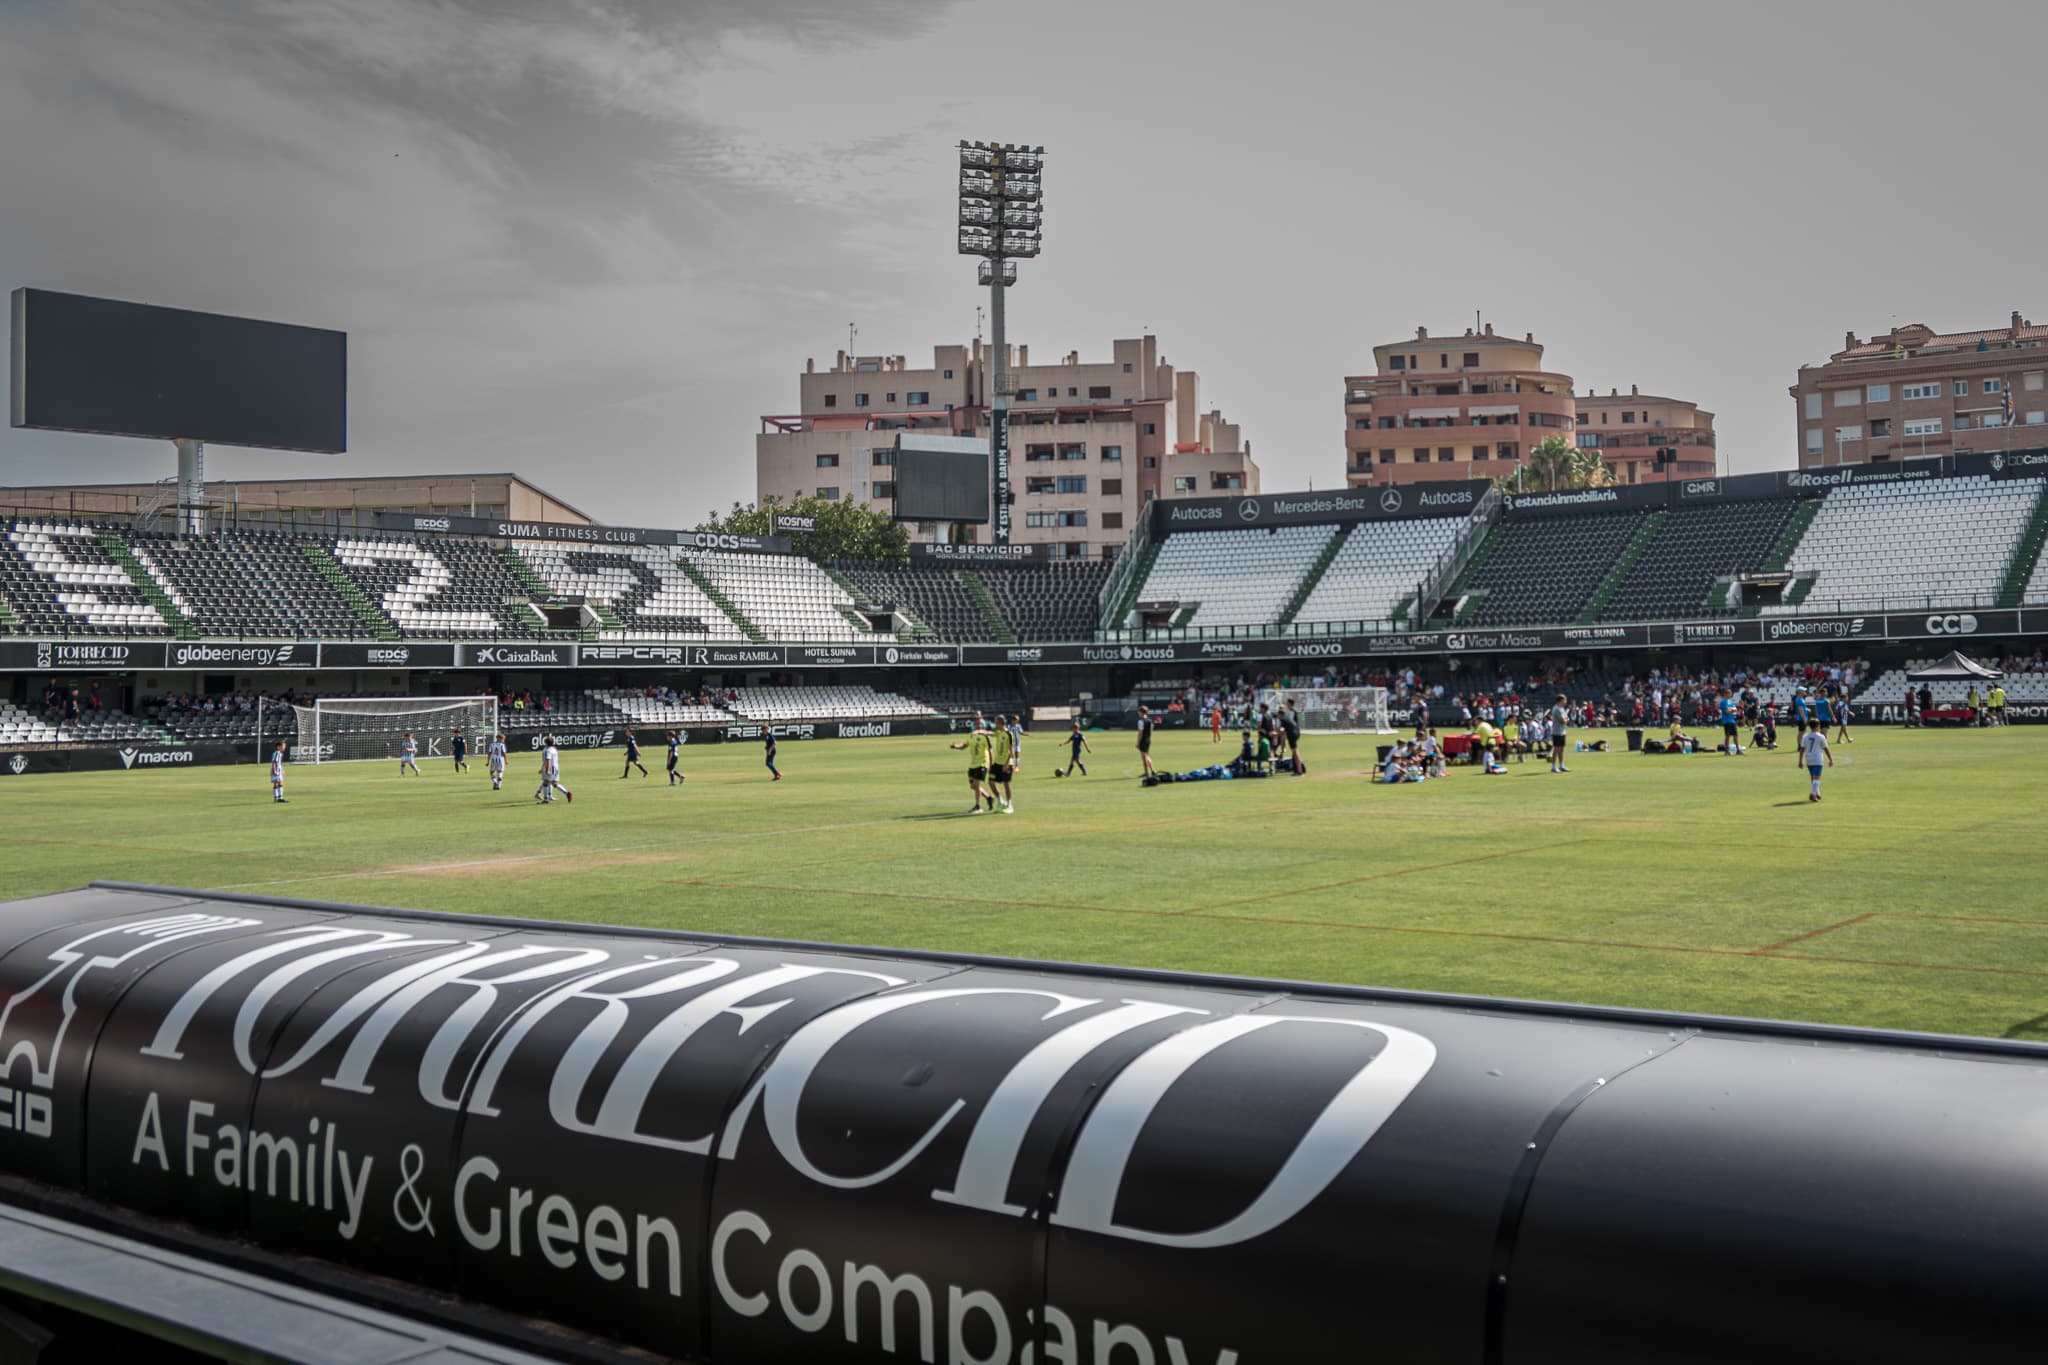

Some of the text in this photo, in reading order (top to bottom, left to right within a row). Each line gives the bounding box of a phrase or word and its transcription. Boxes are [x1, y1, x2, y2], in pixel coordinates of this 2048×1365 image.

[999, 449, 1008, 478] DAMM
[1802, 469, 1931, 487] Rosell DISTRIBUCONES
[1687, 481, 1716, 493] GMR
[1171, 490, 1473, 520] Autocas Mercedes-Benz Autocas
[499, 523, 636, 543] SUMA FITNESS CLUB
[695, 533, 740, 549] CDCS
[925, 544, 1033, 554] SAC SERVICIOS
[1771, 621, 1850, 638] globeenergy
[1926, 614, 1978, 635] CCD
[1564, 628, 1626, 639] HOTEL SUNNA
[55, 646, 129, 659] TORRECID
[177, 645, 276, 665] globeenergy
[582, 647, 682, 659] REPCAR
[805, 648, 856, 657] HOTEL SUNNA
[1083, 645, 1174, 660] frutas bausá
[1202, 643, 1242, 653] Arnau
[1297, 643, 1342, 655] NOVO
[377, 651, 408, 660] CDCS
[496, 649, 558, 663] CaixaBank
[713, 651, 738, 661] fincas
[739, 651, 778, 661] RAMBLA
[727, 724, 815, 738] RECAR
[838, 722, 891, 737] kerakoll
[1808, 737, 1816, 753] 7
[138, 751, 193, 764] macron
[139, 922, 1438, 1248] TORRECID
[132, 1091, 1240, 1365] A Family & Green Compan
